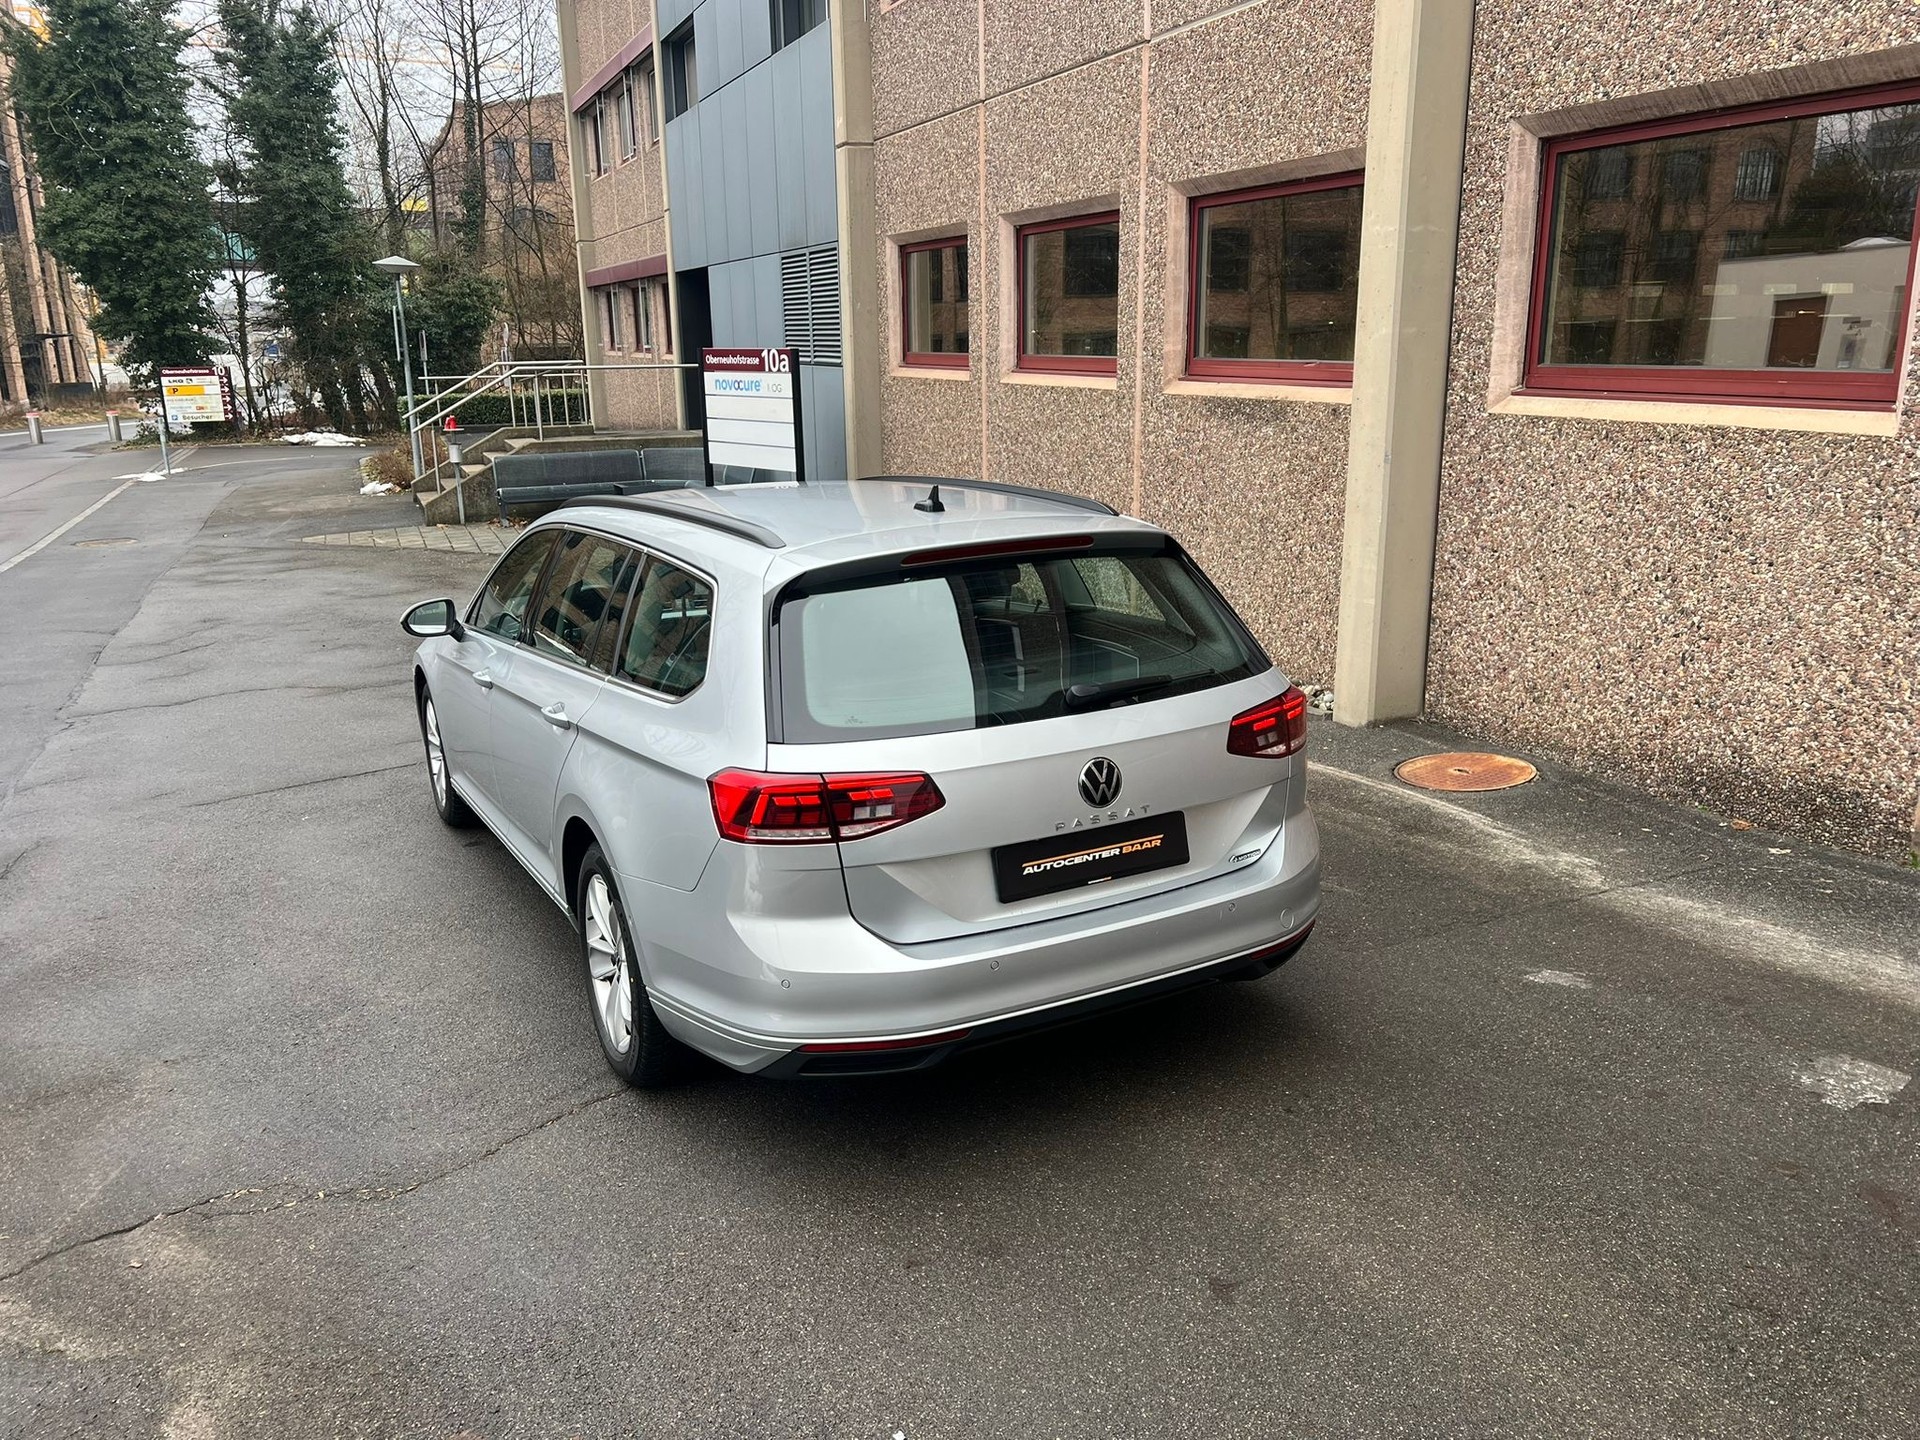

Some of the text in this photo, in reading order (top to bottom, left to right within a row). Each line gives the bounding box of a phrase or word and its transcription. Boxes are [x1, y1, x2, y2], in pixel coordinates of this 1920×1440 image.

[212, 366, 225, 376] 10
[705, 348, 789, 372] Oberneuhofstrasse 10a
[714, 379, 761, 391] novocure
[1054, 804, 1151, 832] PASSAT
[1022, 839, 1162, 876] AUTOCENTER BAAR
